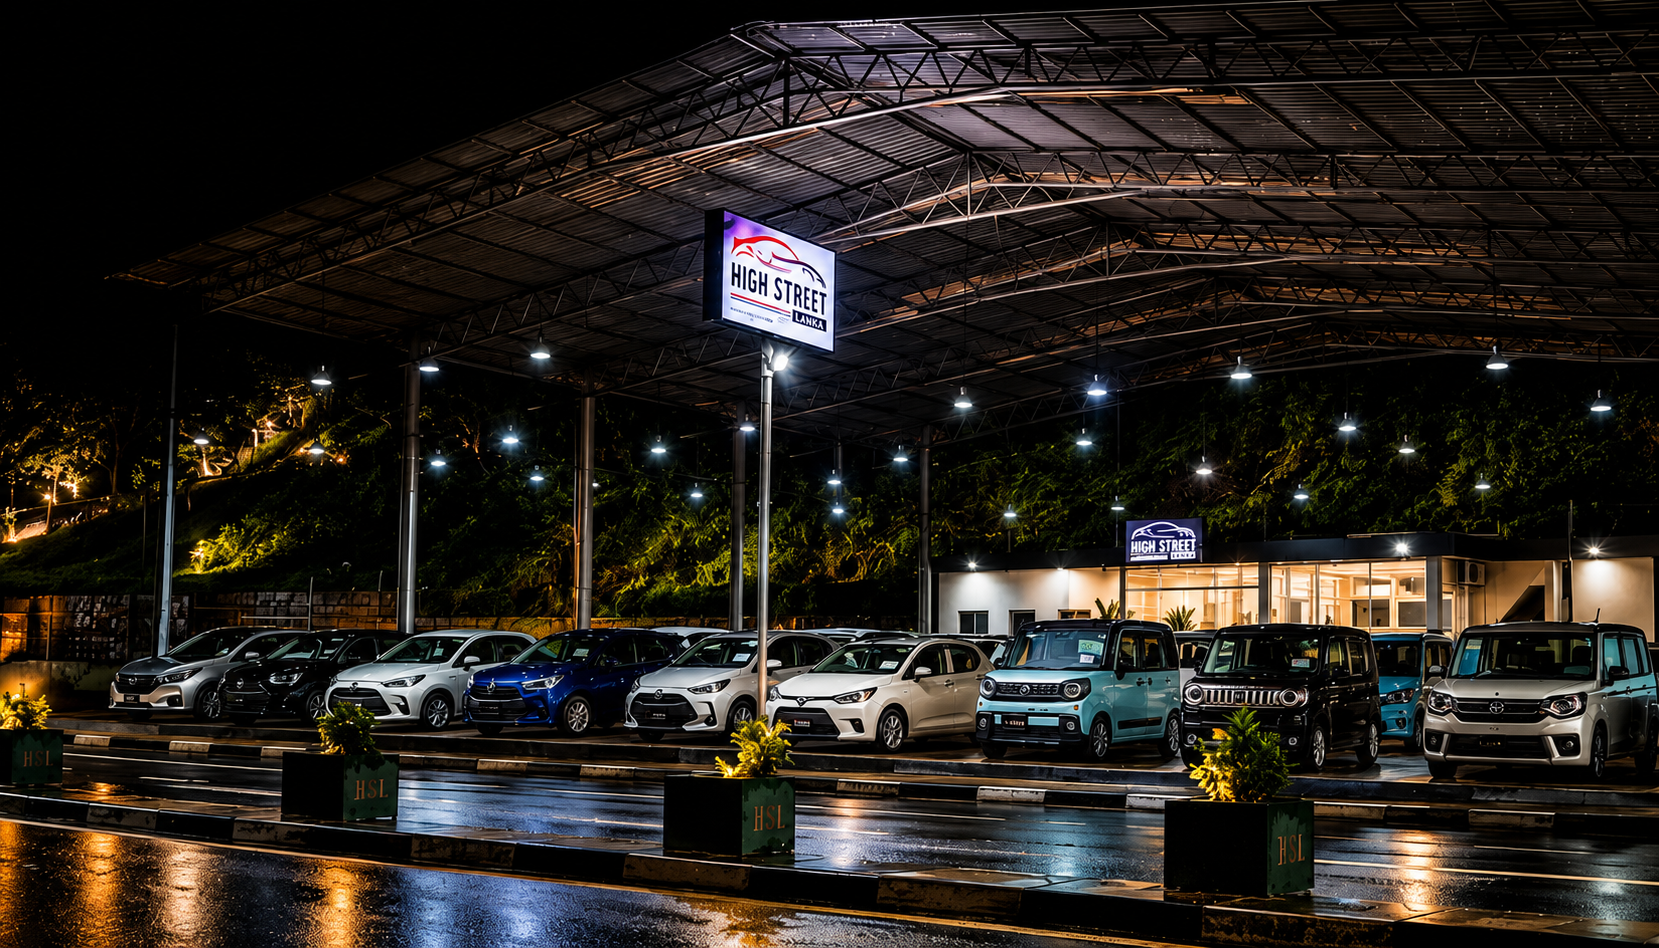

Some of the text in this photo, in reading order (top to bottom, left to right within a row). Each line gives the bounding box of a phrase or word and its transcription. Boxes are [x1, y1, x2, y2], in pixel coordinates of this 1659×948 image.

[731, 262, 768, 297] HIGH
[774, 277, 827, 315] STREET
[795, 312, 824, 330] LANKA
[1131, 539, 1196, 553] HIGH STREET
[24, 750, 53, 767] HSL
[354, 779, 388, 800] HSL
[754, 805, 785, 831] HSL
[1278, 834, 1305, 865] HSL
